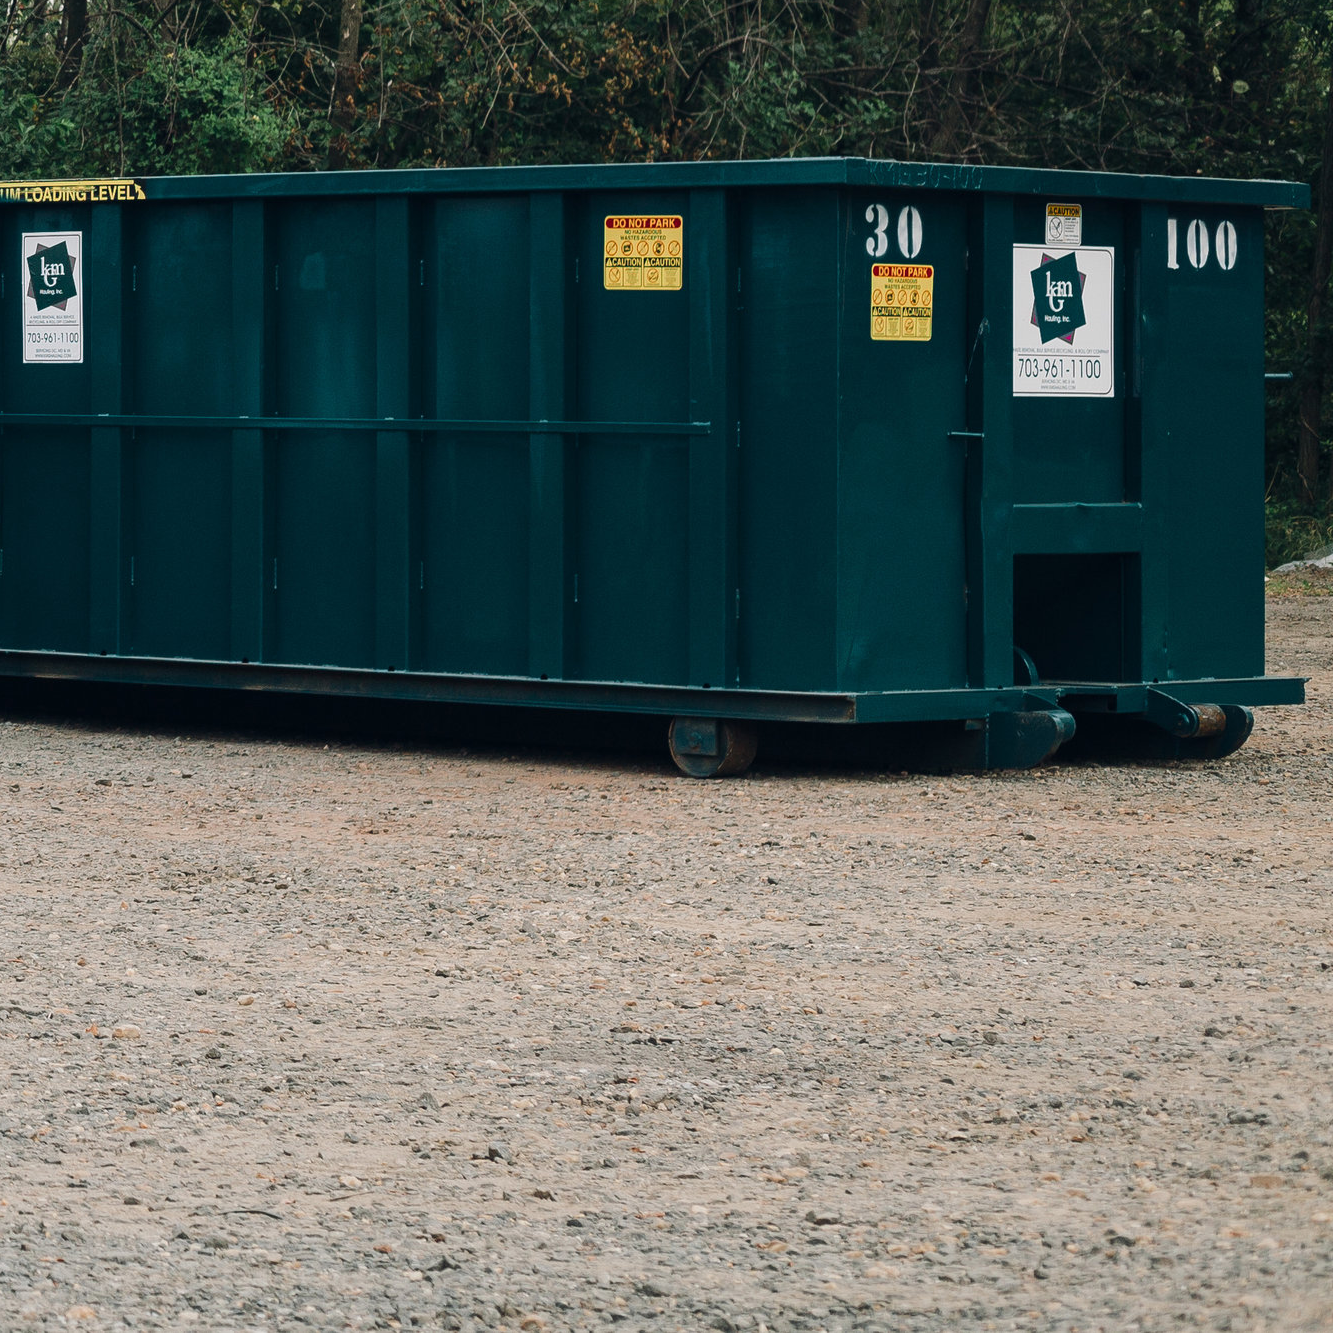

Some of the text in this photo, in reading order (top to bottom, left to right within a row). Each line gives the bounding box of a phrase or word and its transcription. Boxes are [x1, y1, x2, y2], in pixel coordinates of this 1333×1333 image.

[25, 187, 86, 202] LOADING
[90, 185, 135, 201] LEVEL
[1054, 208, 1079, 216] CAUTION
[613, 218, 675, 228] DO NOT PARK
[865, 204, 923, 259] 30
[1167, 219, 1238, 270] 100
[651, 258, 680, 266] CAUTION
[878, 266, 928, 277] DO NOT PARK
[877, 308, 901, 316] CAUTION
[908, 308, 931, 316] CAUTION
[28, 332, 79, 343] 703-961-1100
[1018, 358, 1101, 378] 703-961-1100
